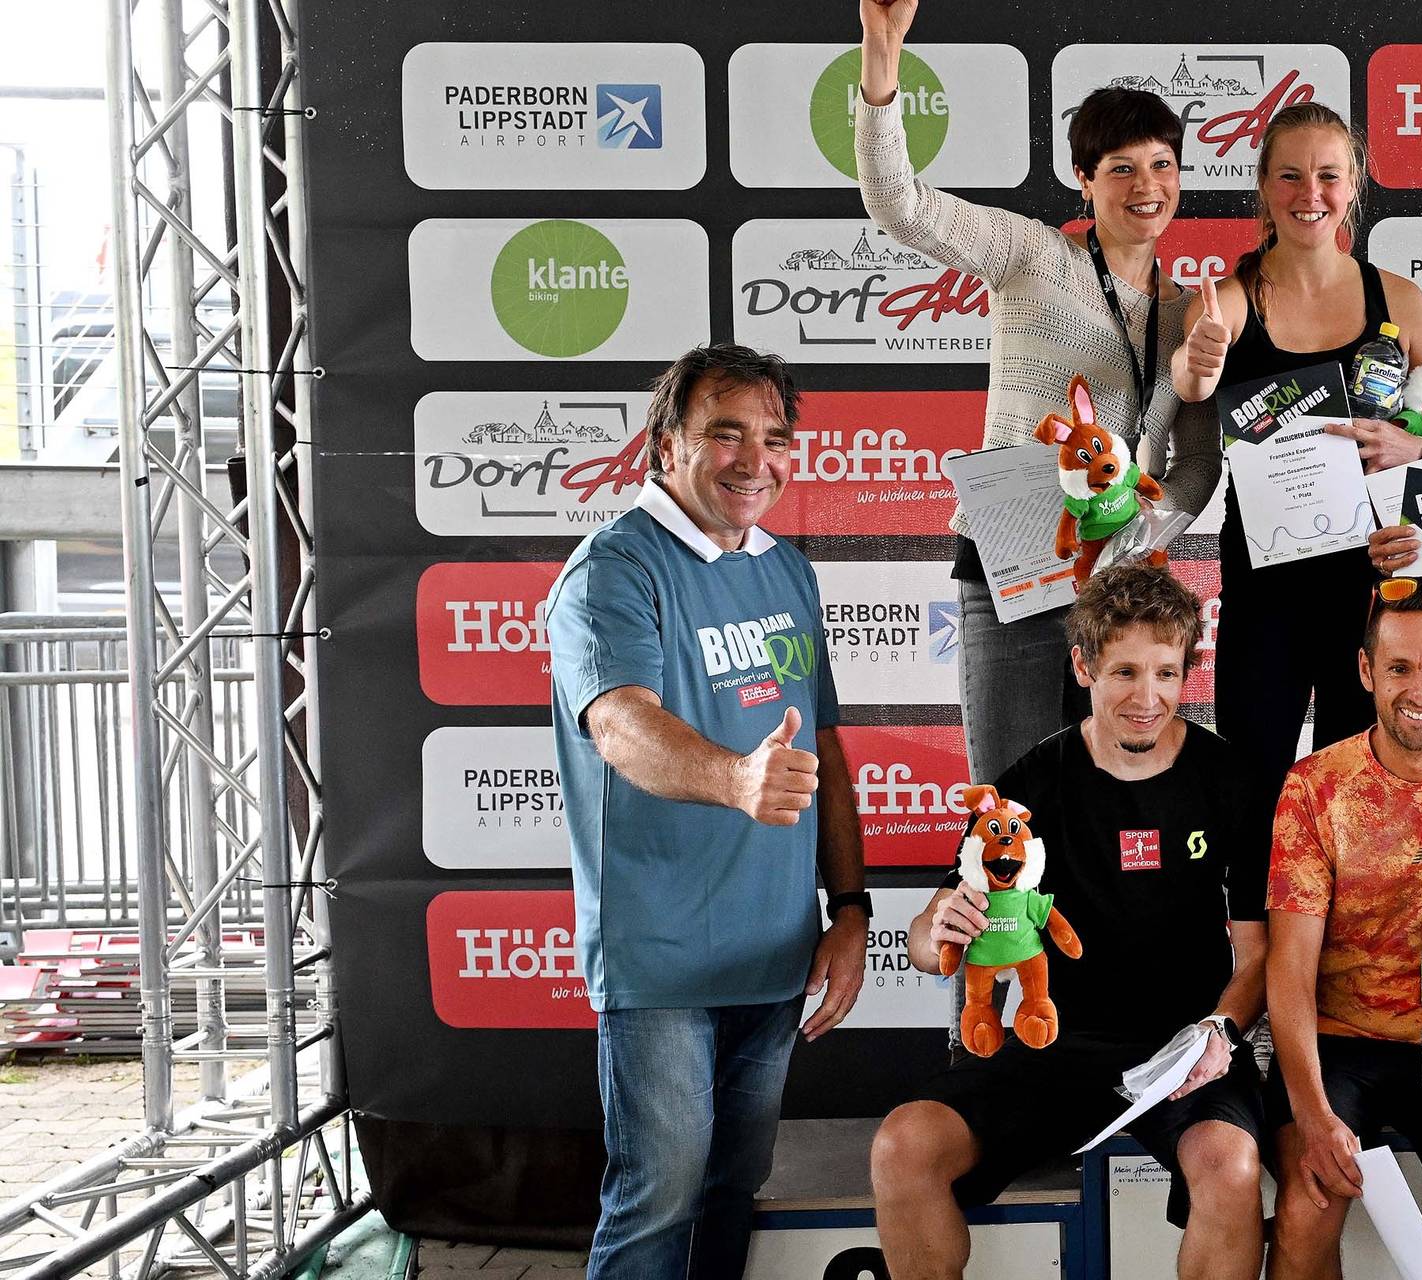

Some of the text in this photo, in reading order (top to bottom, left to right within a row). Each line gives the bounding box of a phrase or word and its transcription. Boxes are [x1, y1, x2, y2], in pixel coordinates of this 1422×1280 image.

[445, 86, 587, 105] PADERBORN
[848, 84, 948, 115] knte
[459, 111, 587, 129] LIPPSTADT
[460, 135, 585, 146] AIRPORT
[528, 258, 628, 289] klante
[529, 291, 559, 302] biking
[885, 338, 992, 350] WINTERBE
[1230, 378, 1302, 429] BOB BAHN RUN
[1276, 385, 1331, 427] URKUNDE
[1275, 431, 1305, 445] HERZLICHEN
[857, 491, 876, 503] Wo
[880, 487, 925, 502] Wohnen
[821, 604, 920, 623] ERBORN
[823, 627, 920, 646] PSTADT
[697, 612, 815, 685] BOB BAHN RU
[830, 650, 917, 662] RPORT
[465, 769, 560, 788] PADERB
[853, 763, 972, 815] ffne
[477, 793, 563, 811] LIPPST
[478, 816, 562, 827] AIRPO
[864, 823, 882, 836] Wo
[886, 820, 931, 835] Wohnen
[1125, 831, 1154, 839] SPORT
[552, 987, 570, 999] Wo
[1114, 1165, 1132, 1174] Mein
